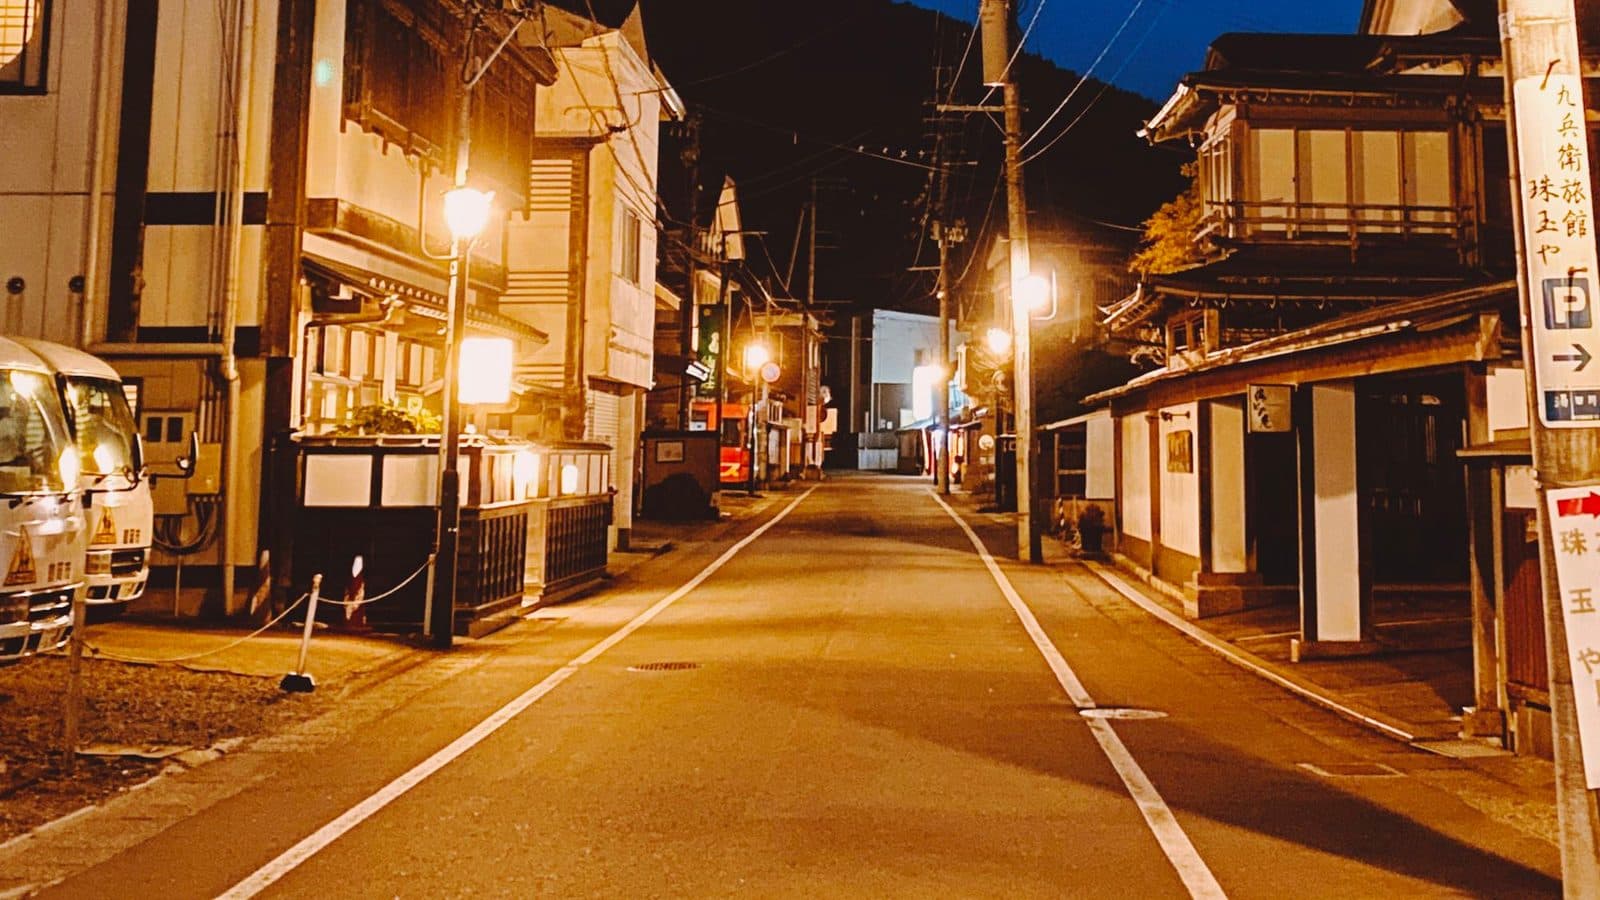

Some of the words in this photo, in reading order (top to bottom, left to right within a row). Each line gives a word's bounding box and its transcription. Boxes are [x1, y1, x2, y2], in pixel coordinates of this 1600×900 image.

[1557, 84, 1588, 238] 九兵衛旅館
[1528, 175, 1560, 266] 珠玉や
[1553, 286, 1586, 323] P
[1560, 528, 1600, 674] 珠玉や
